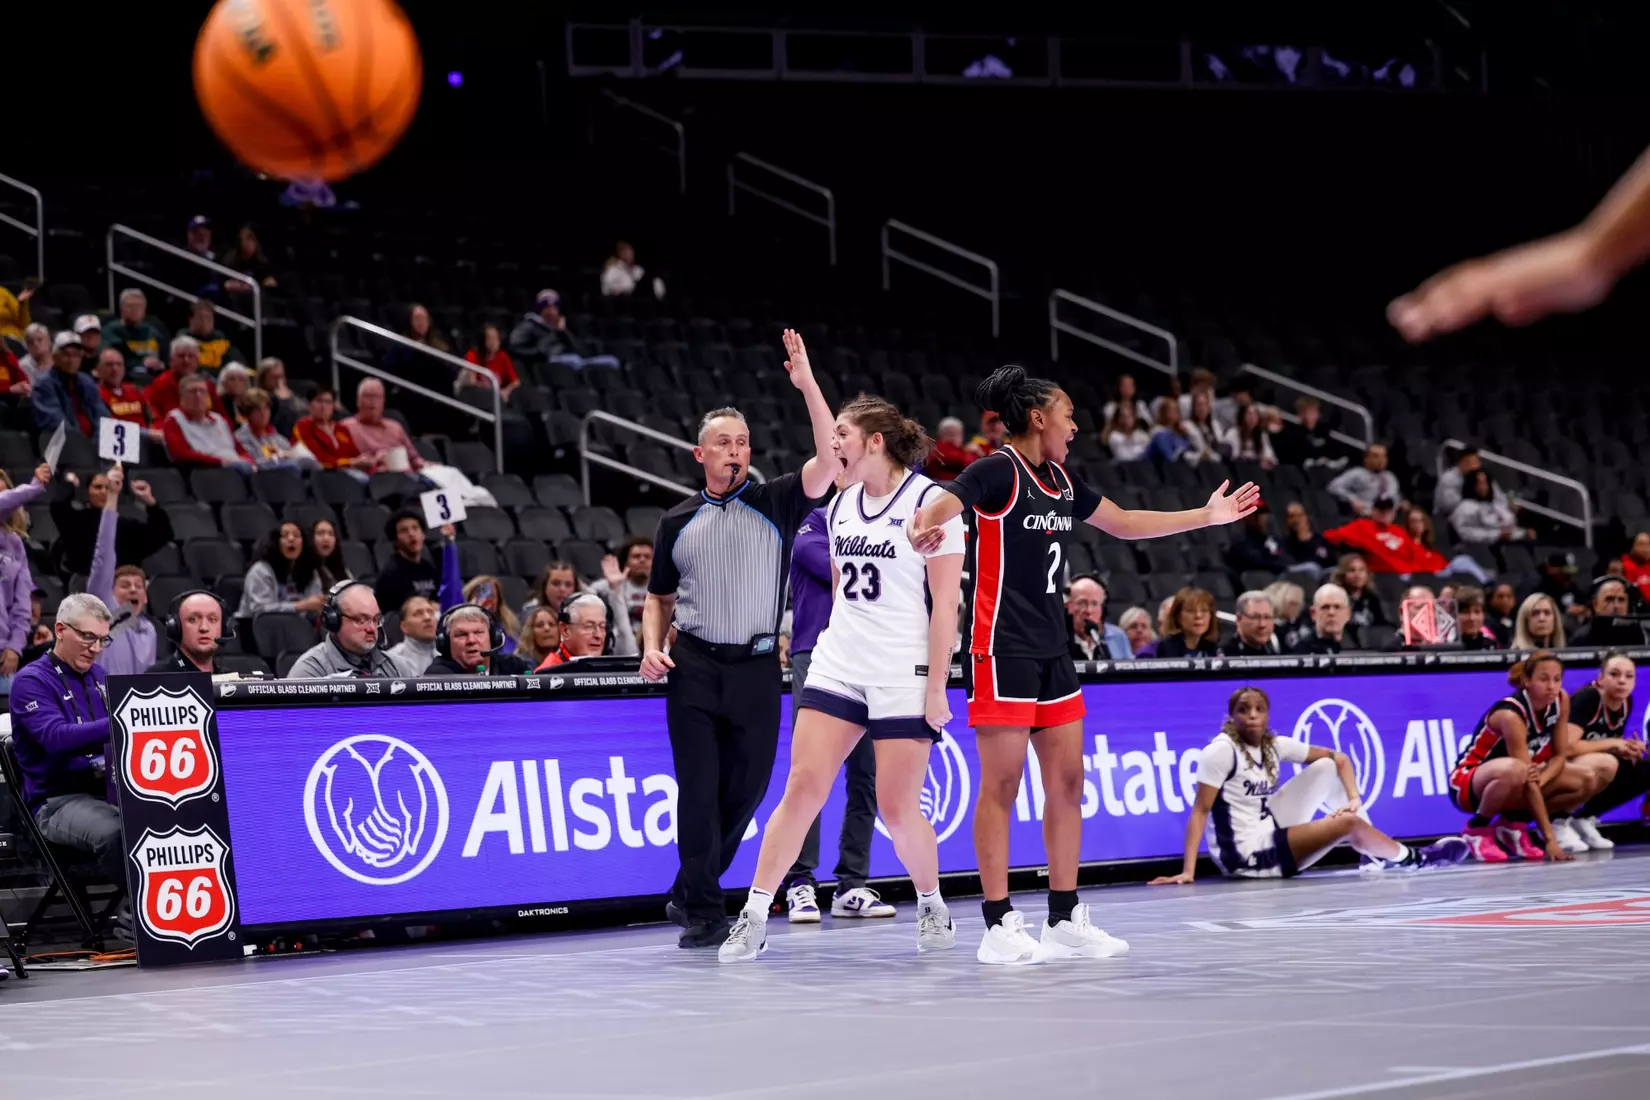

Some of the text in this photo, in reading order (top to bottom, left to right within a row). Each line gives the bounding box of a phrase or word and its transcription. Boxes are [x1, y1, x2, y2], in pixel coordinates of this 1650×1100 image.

[112, 424, 126, 457] 3
[436, 494, 451, 520] 3
[835, 535, 897, 559] Wildcats
[1046, 541, 1061, 594] 2
[842, 562, 881, 602] 23
[248, 684, 277, 694] OFFICIAL
[278, 684, 298, 694] GLASS
[298, 684, 328, 694] CLEANING
[329, 684, 357, 693] PARTNER
[416, 682, 443, 692] OFFICIAL
[444, 681, 462, 691] GLASS
[462, 681, 491, 690] CLEANING
[492, 680, 517, 689] PARTNER
[574, 677, 599, 687] OFFICIAL
[599, 677, 617, 686] GLASS
[617, 676, 644, 685] CLEANING
[130, 705, 198, 727] PHILLIPS
[140, 737, 197, 781] 66
[146, 843, 214, 867] PHILLIPS
[156, 876, 213, 921] 66
[518, 906, 569, 917] DAKTRONICS
